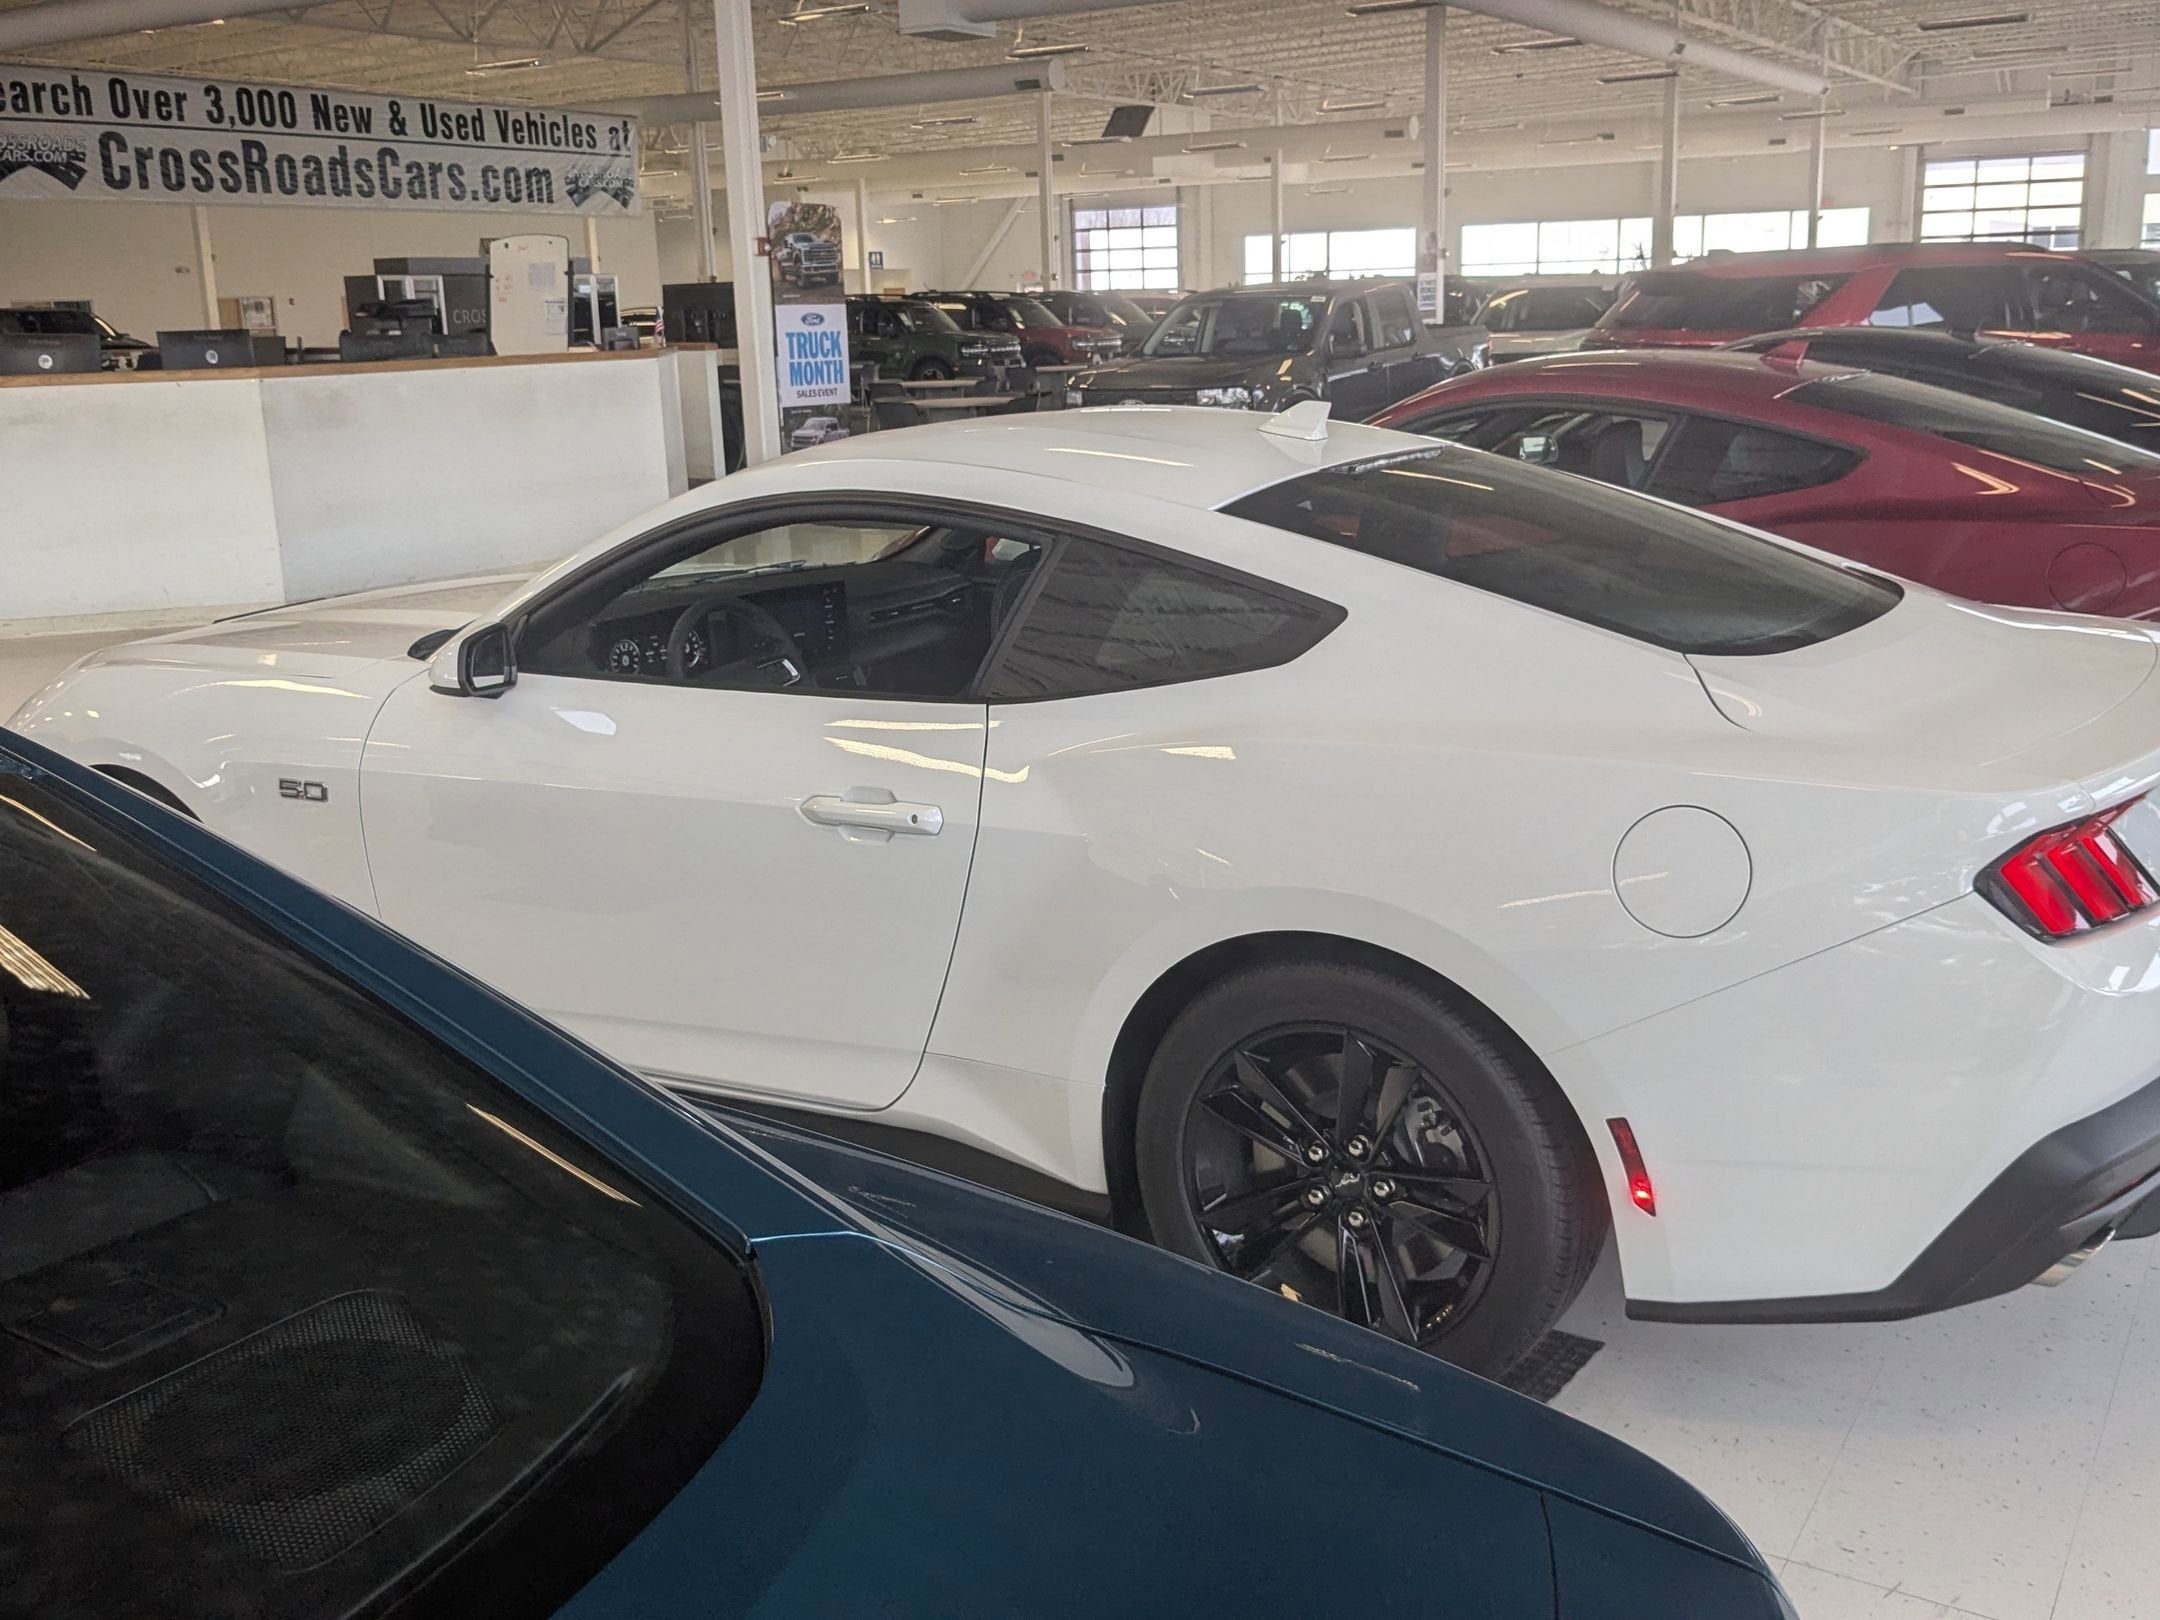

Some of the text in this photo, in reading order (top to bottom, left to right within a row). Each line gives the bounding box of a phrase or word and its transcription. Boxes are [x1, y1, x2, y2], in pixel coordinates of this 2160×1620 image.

[0, 75, 631, 153] arch Over 3,000 New & Used Vehicles at
[0, 149, 67, 164] ARS.COM
[98, 130, 555, 205] CrossRoadsCars.com
[786, 331, 842, 359] TRUCK
[789, 360, 843, 386] MONTH
[797, 388, 838, 399] SALES EVENT
